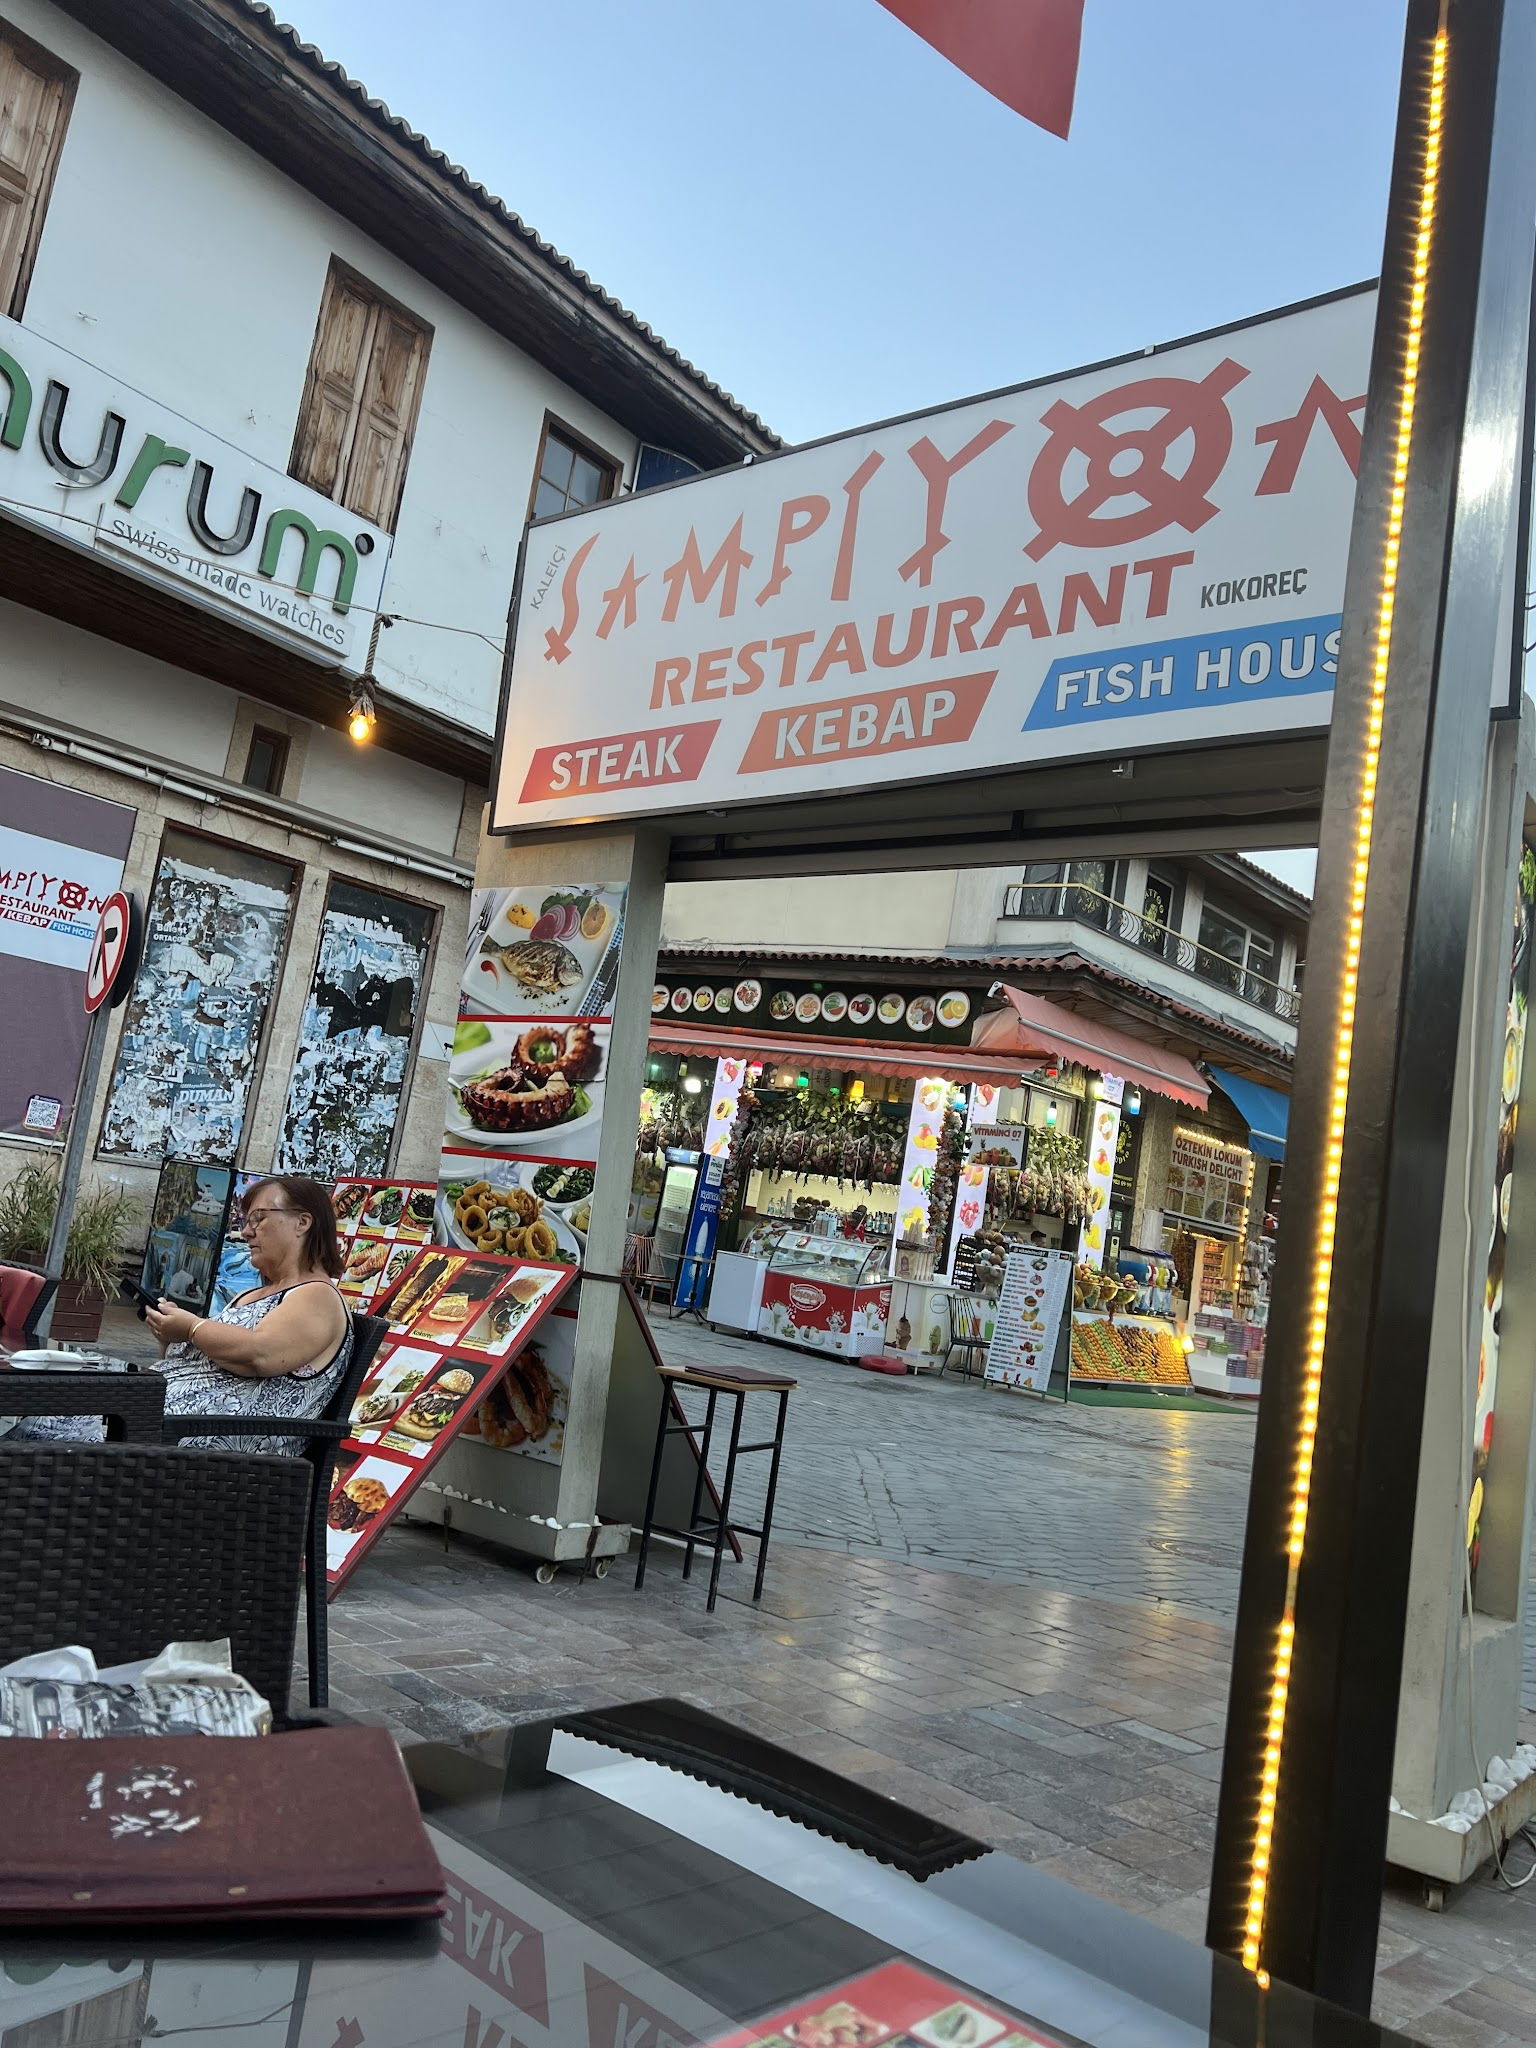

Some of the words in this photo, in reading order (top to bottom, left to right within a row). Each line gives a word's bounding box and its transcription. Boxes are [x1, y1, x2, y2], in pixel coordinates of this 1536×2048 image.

[112, 519, 181, 566] swiss
[186, 558, 252, 600] made
[260, 589, 346, 646] watches
[530, 544, 568, 610] KALEİÇİ
[1201, 567, 1308, 609] KOKOREÇ
[649, 550, 1195, 710] RESTAURANT
[1055, 656, 1175, 713] FISH
[774, 689, 957, 762] KEBAP
[548, 733, 684, 792] STEAK
[7, 911, 48, 926] KEBAP
[53, 922, 71, 933] FISH
[180, 1088, 234, 1103] DUMAN
[1012, 1130, 1022, 1139] 07
[1175, 1133, 1213, 1159] ÖZTEKİN
[1213, 1147, 1243, 1168] LOKUM
[1172, 1150, 1208, 1173] TURKISH
[1209, 1161, 1244, 1182] DELIGHT
